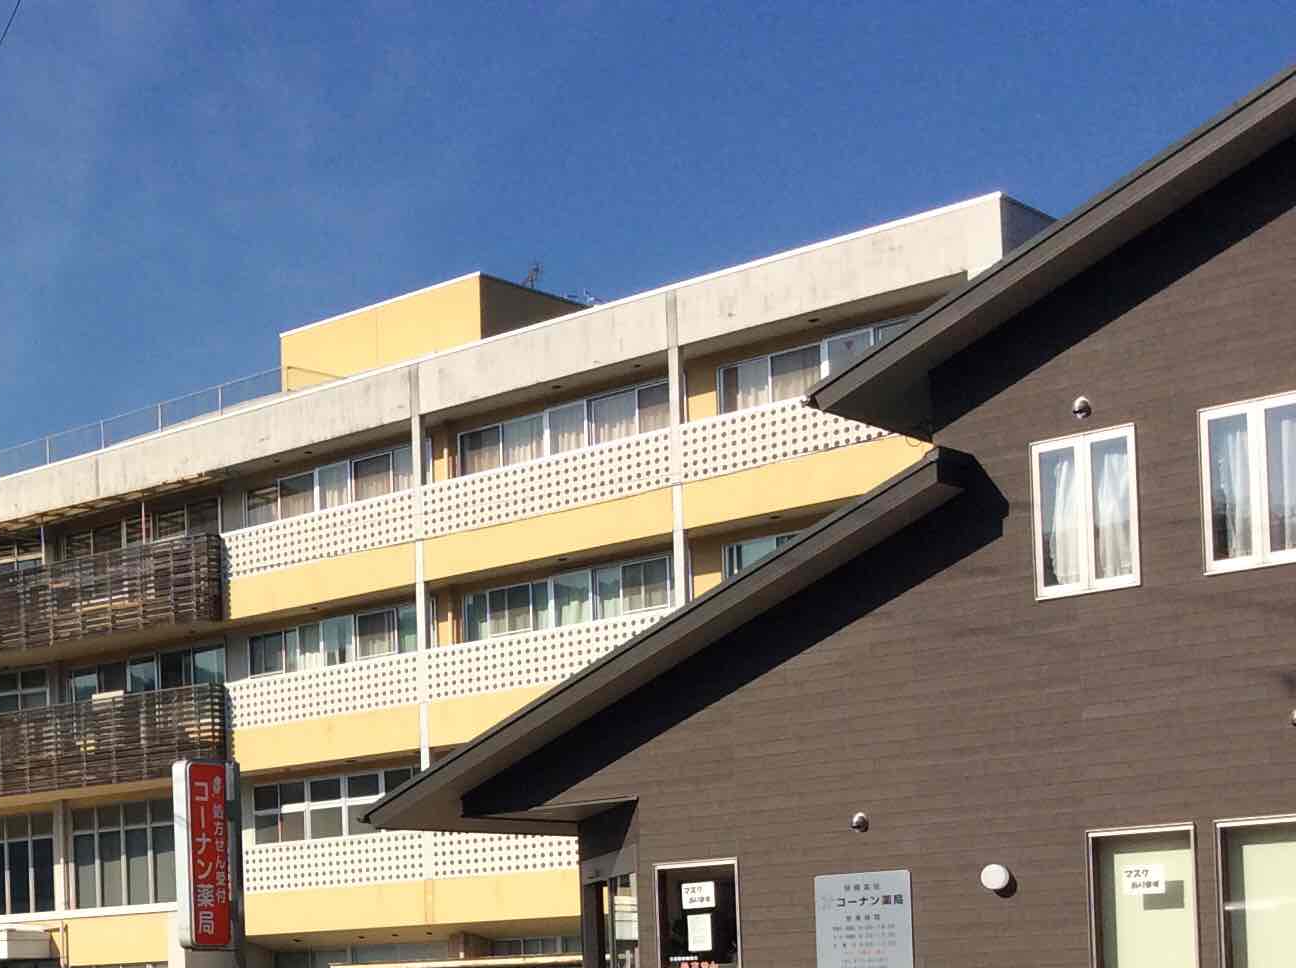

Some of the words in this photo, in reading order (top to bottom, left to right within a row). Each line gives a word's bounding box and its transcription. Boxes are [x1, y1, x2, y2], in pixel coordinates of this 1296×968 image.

[194, 781, 215, 935] コーナン薬局
[212, 804, 227, 904] 処方せん受付
